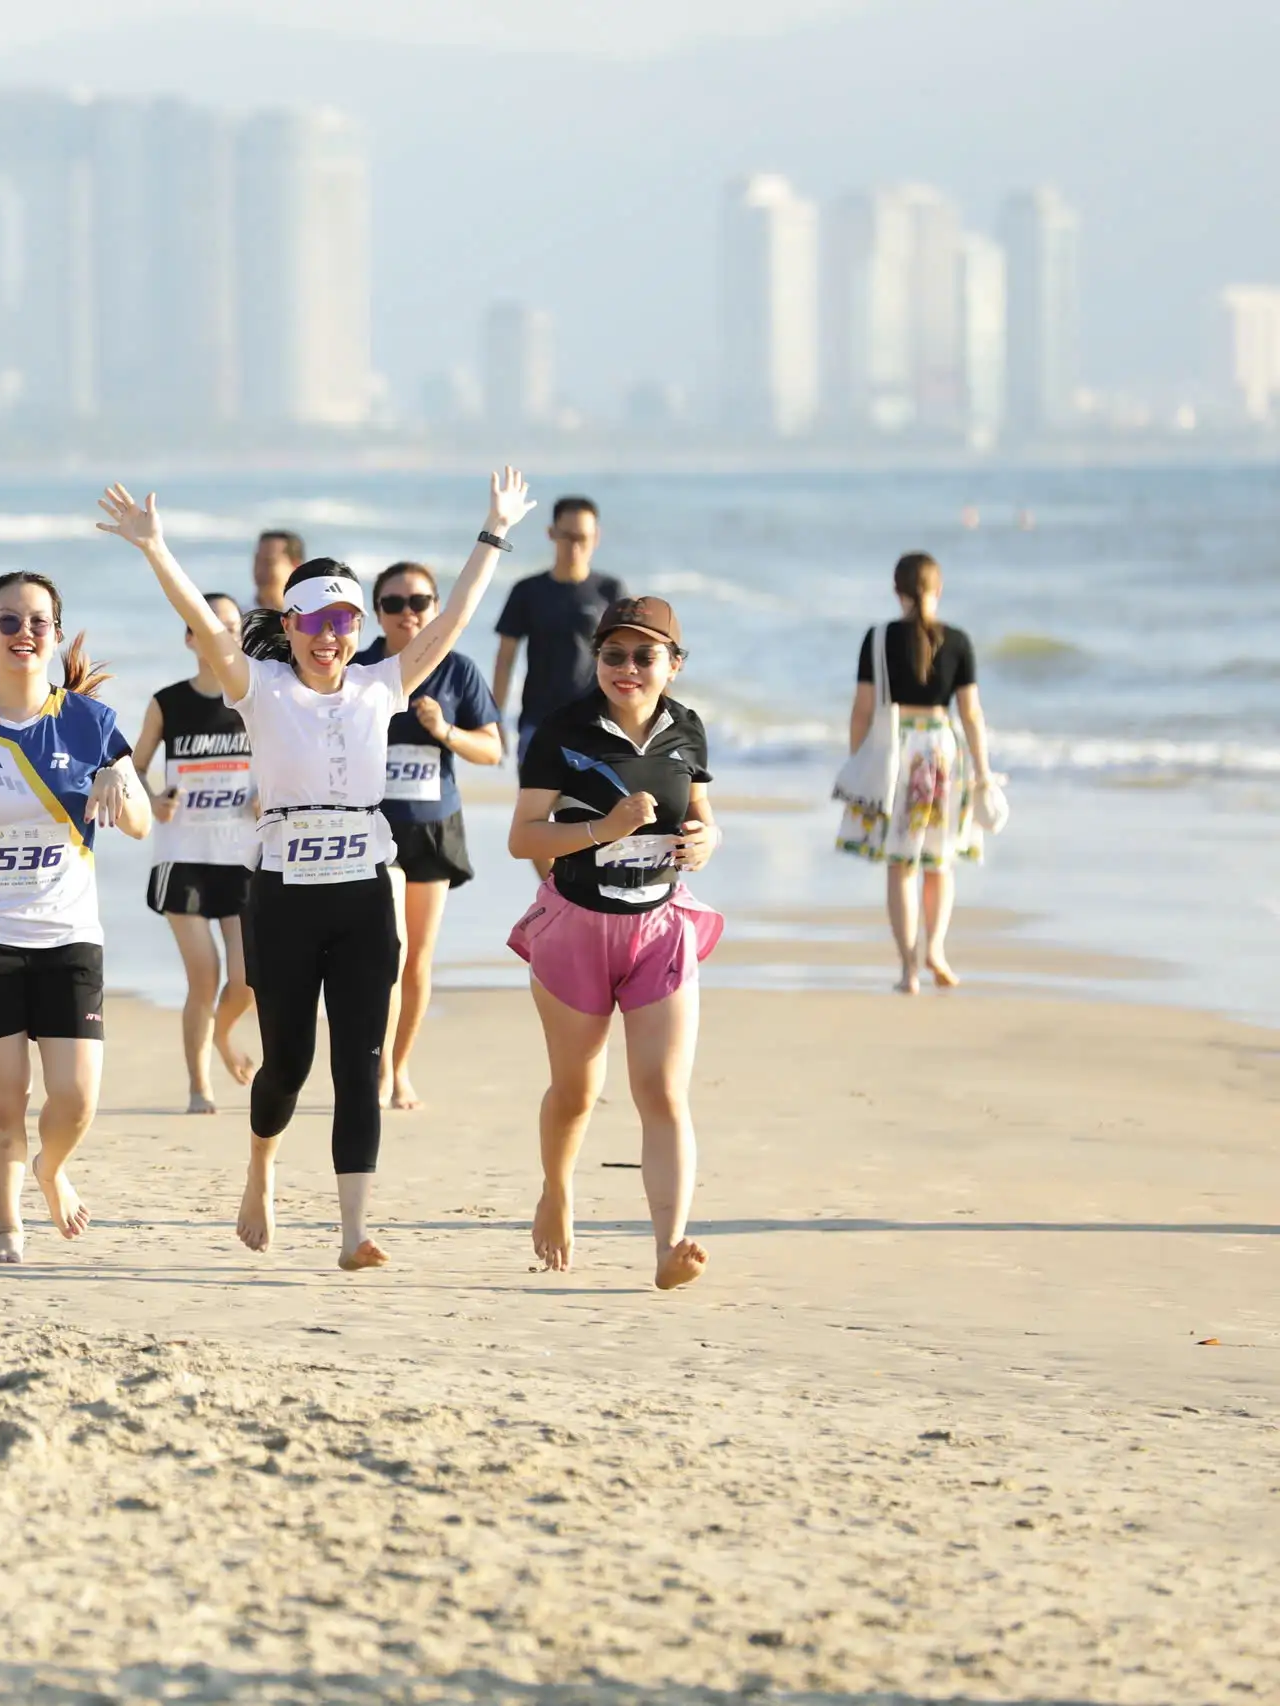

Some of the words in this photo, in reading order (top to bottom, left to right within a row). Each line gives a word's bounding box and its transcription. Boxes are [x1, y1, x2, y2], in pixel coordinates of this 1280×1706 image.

[386, 761, 436, 782] 598
[186, 787, 248, 809] 1626
[287, 833, 368, 862] 1535
